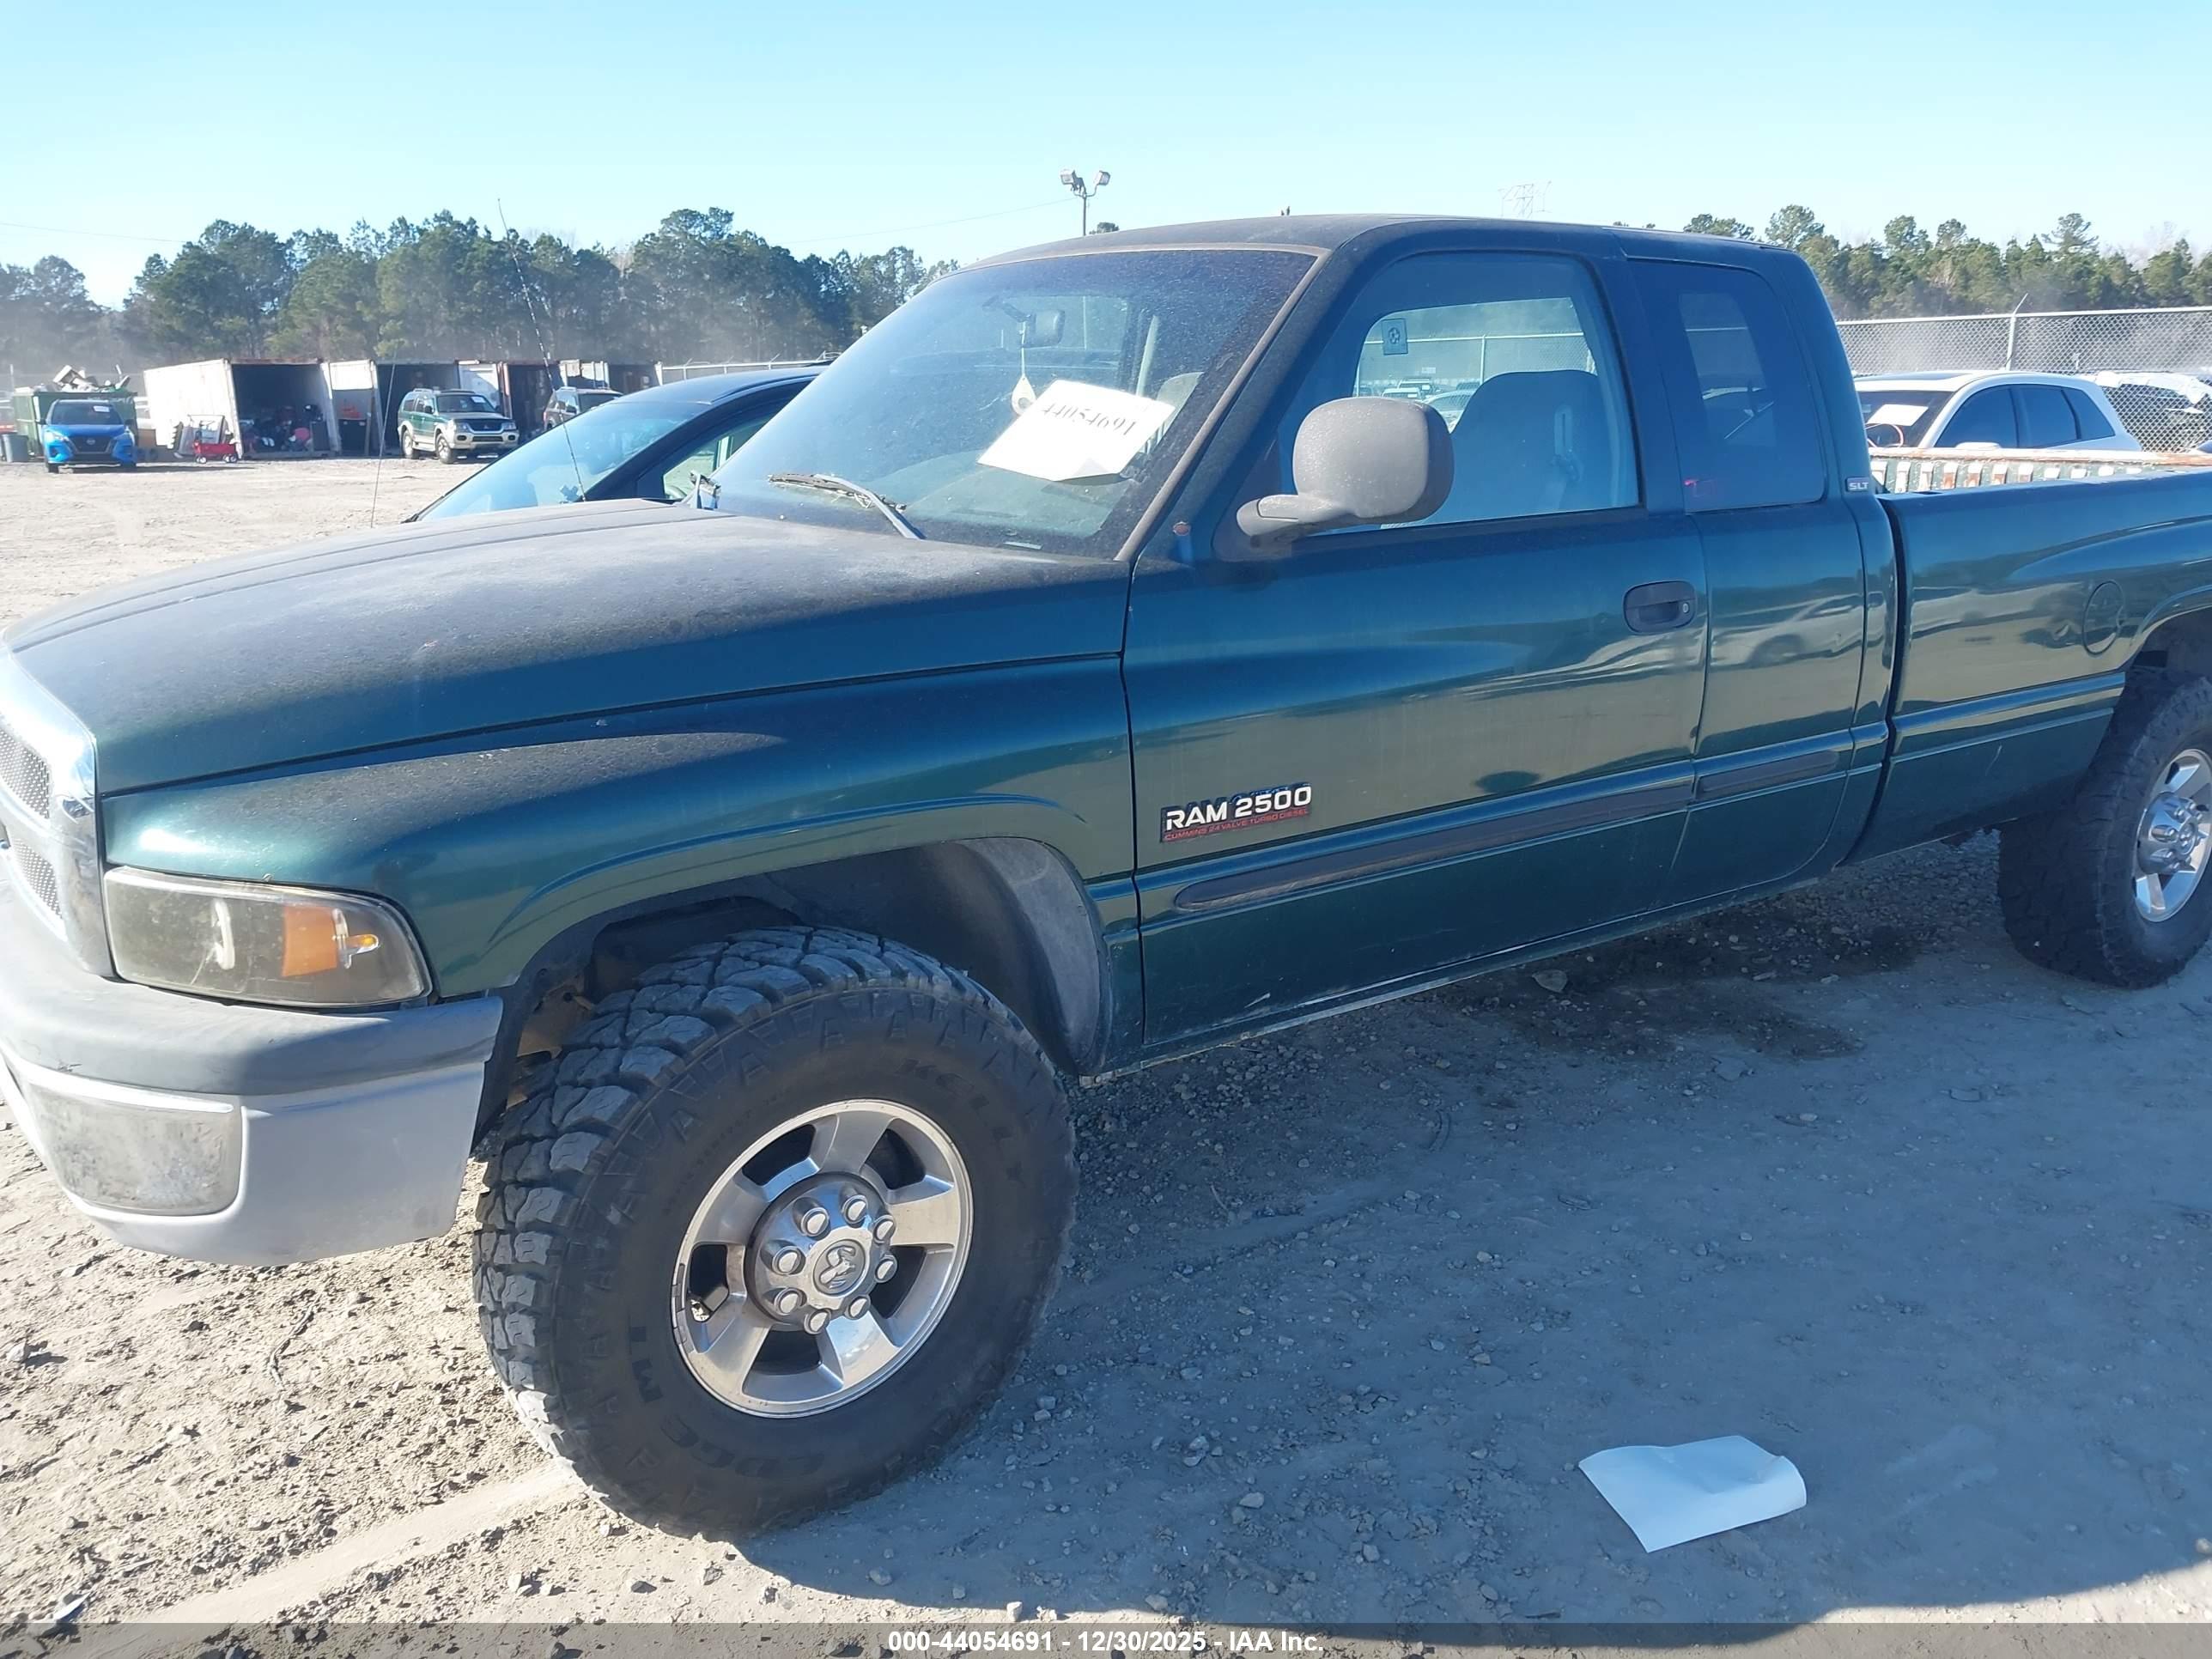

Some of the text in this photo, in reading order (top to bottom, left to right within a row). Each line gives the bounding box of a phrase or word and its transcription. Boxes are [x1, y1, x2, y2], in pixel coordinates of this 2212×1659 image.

[1849, 482, 1869, 490] SLT
[1164, 807, 1309, 840] CUMMINS 24 VALVE TURBO DIESEL
[1166, 786, 1312, 831] RAM 2500
